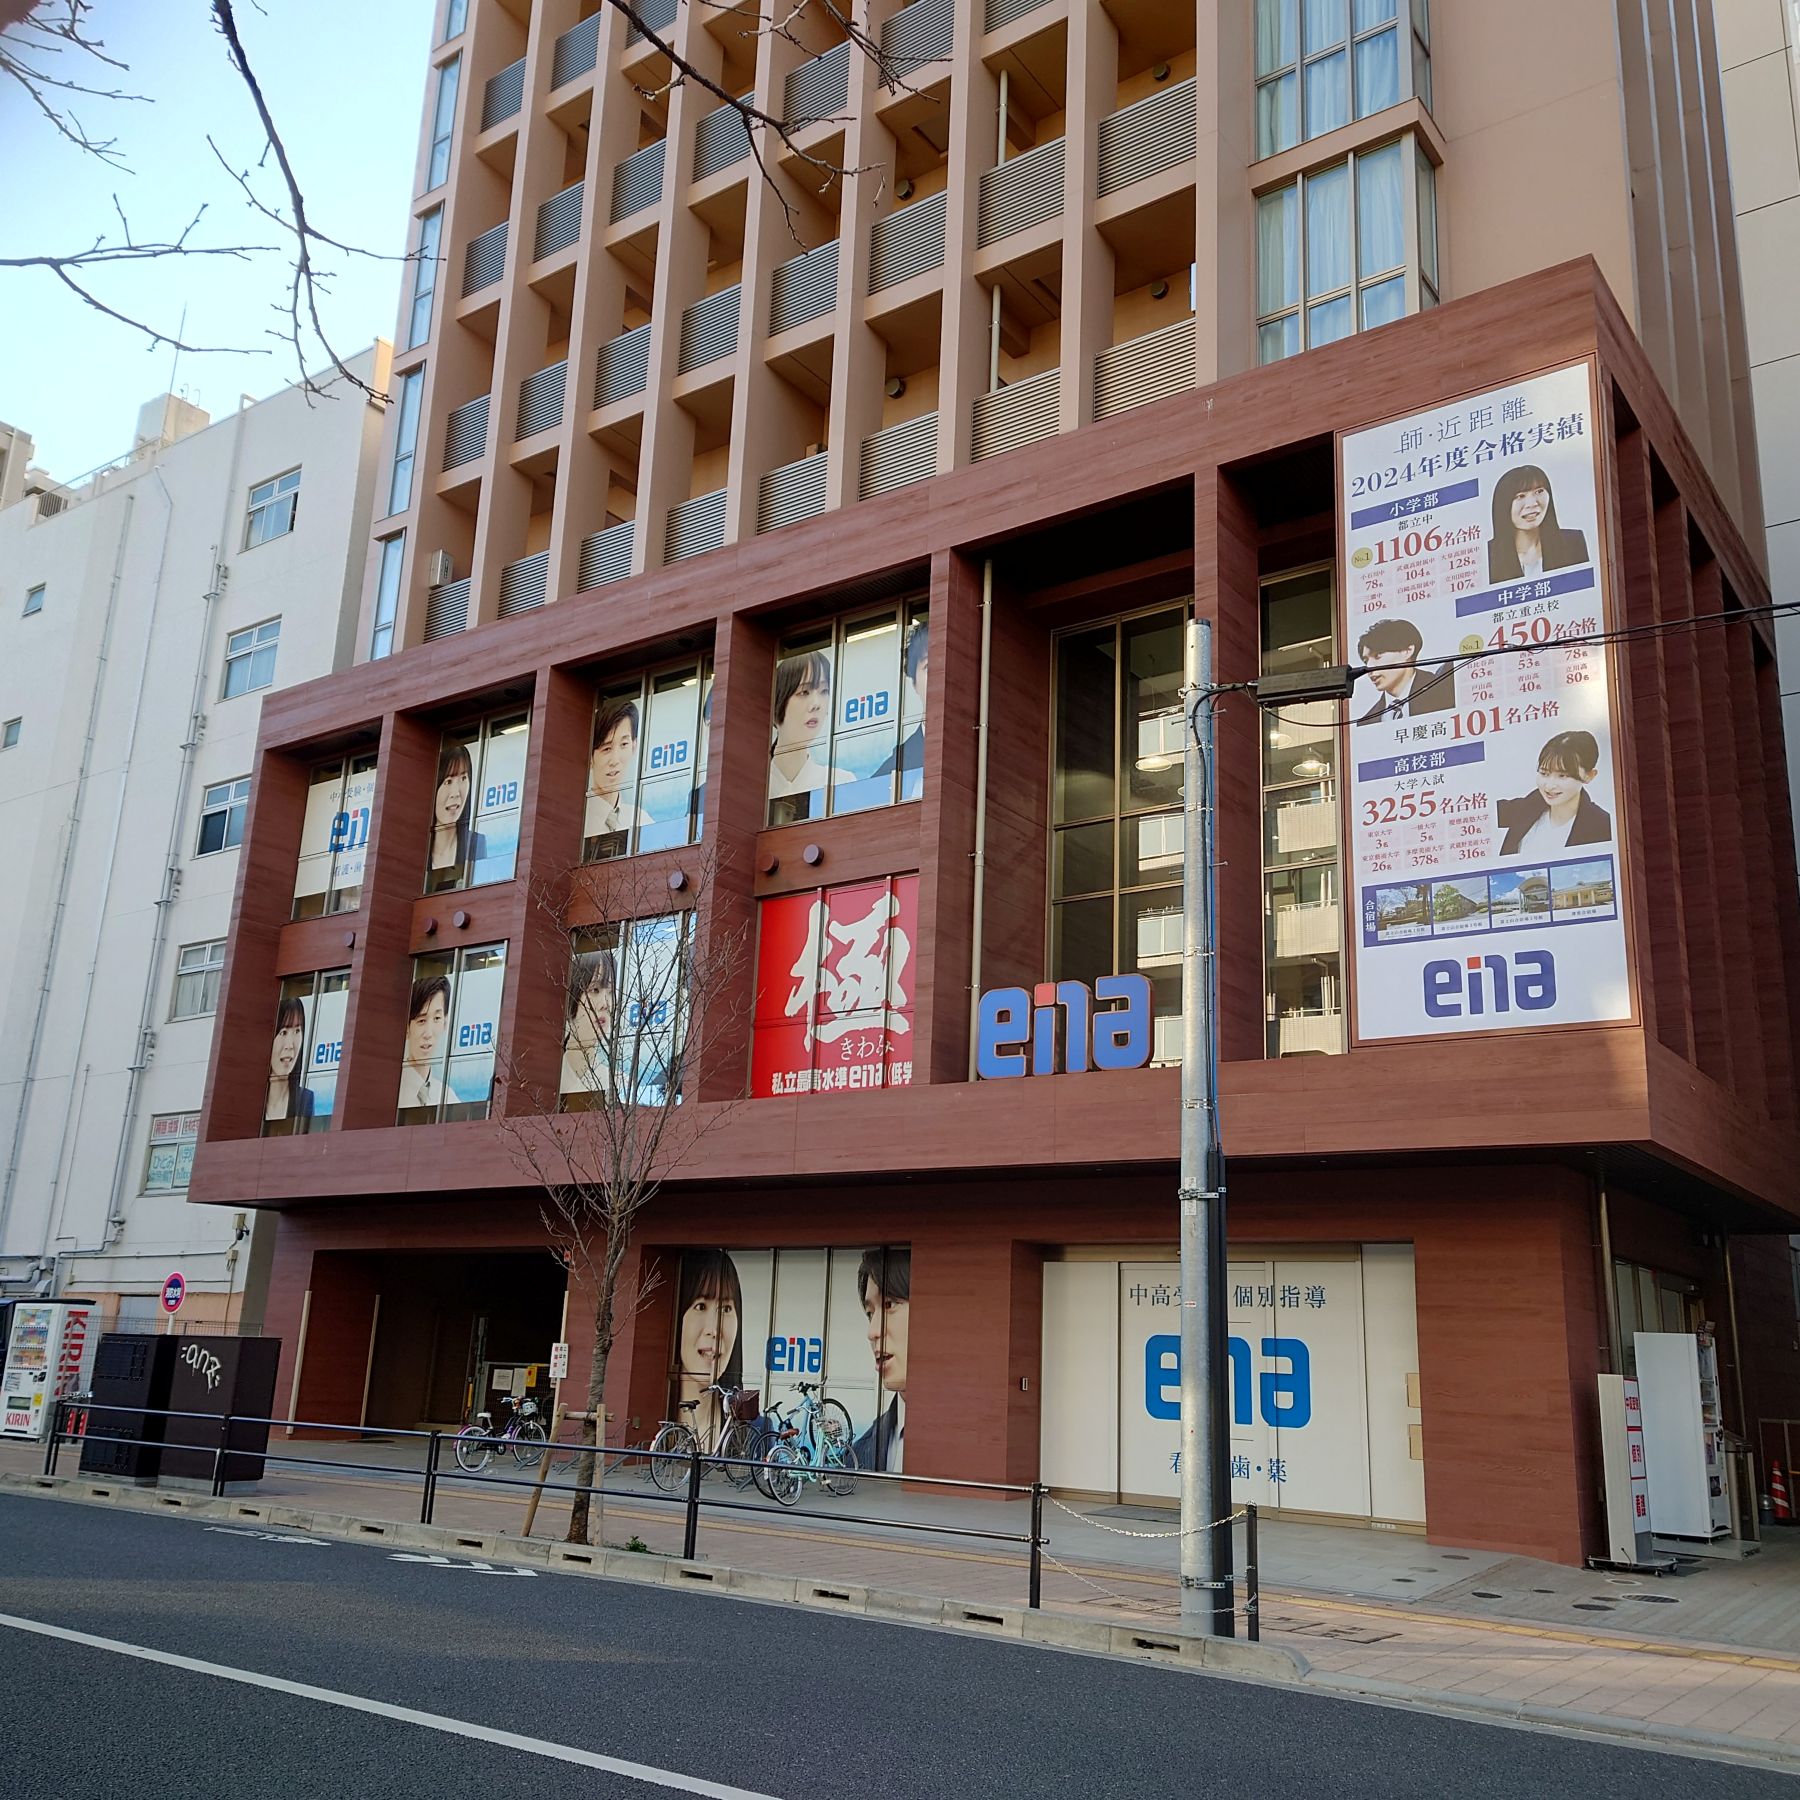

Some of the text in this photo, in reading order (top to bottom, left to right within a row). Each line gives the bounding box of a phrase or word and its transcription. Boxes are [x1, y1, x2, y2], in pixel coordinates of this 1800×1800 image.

[1352, 413, 1584, 497] 2024年度合格実績
[1389, 492, 1439, 517] 小学部
[1398, 514, 1433, 531] 都立中
[1374, 525, 1481, 565] 1106名合格
[1498, 580, 1551, 605] 中学部
[1492, 600, 1559, 623] 都立重点校
[1488, 617, 1597, 650] 450名合格
[1463, 641, 1480, 652] No.1
[1394, 700, 1560, 744] 早慶高101名合格
[1394, 751, 1446, 774] 高校部
[1394, 773, 1445, 792] 大学入試
[1362, 790, 1488, 826] 3255名合格
[1365, 900, 1376, 932] 合宿場
[840, 1034, 895, 1061] きわみ
[5, 1412, 31, 1427] KIRIN
